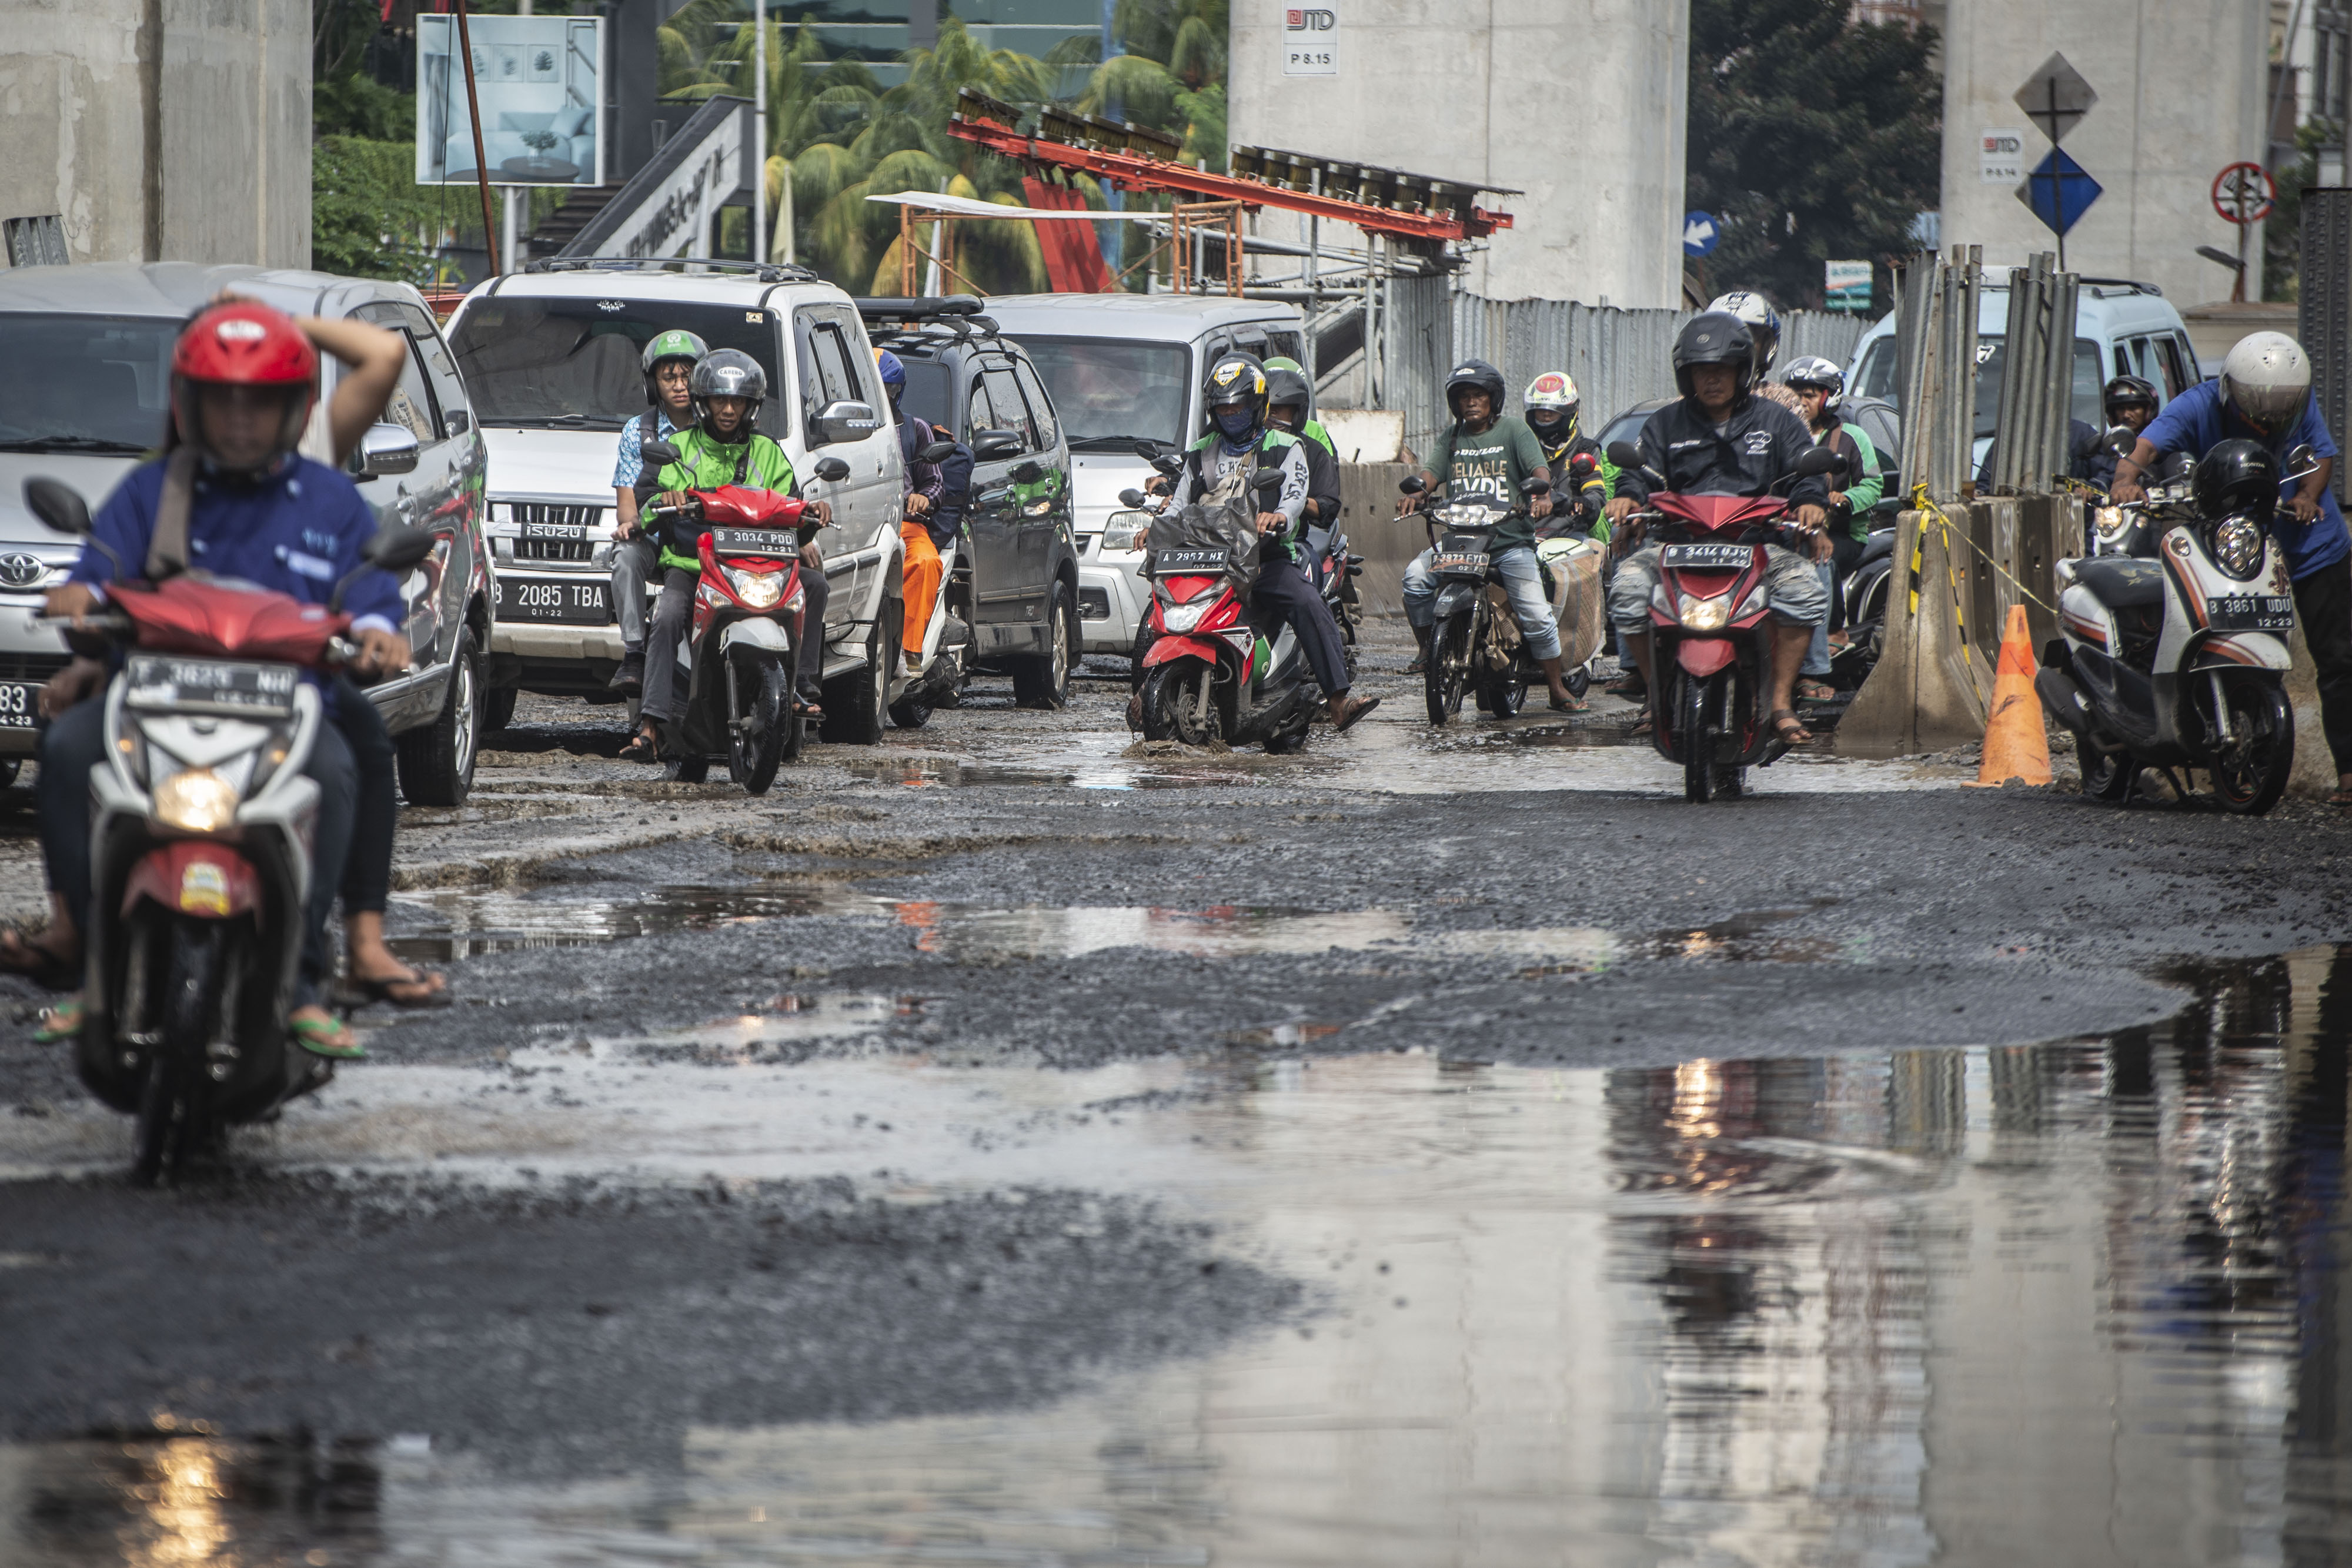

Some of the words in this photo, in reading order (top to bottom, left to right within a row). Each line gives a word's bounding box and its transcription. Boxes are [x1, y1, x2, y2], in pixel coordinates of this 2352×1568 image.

[1291, 54, 1299, 63] P
[1303, 53, 1331, 64] 8.15
[1459, 446, 1504, 456] DUNLOP
[1451, 460, 1507, 479] RELIABLE
[526, 526, 581, 538] ISUZU
[717, 531, 725, 541] B
[734, 532, 764, 542] 3034
[770, 534, 793, 544] PDD
[1162, 553, 1169, 562] A
[1176, 552, 1204, 561] 2957
[1208, 551, 1224, 560] HX
[1668, 547, 1678, 557] B
[496, 583, 502, 604] B
[518, 584, 562, 606] 2085
[572, 586, 603, 608] TBA
[2209, 600, 2218, 614] B
[2224, 599, 2257, 613] 3861
[2266, 599, 2291, 612] UDU
